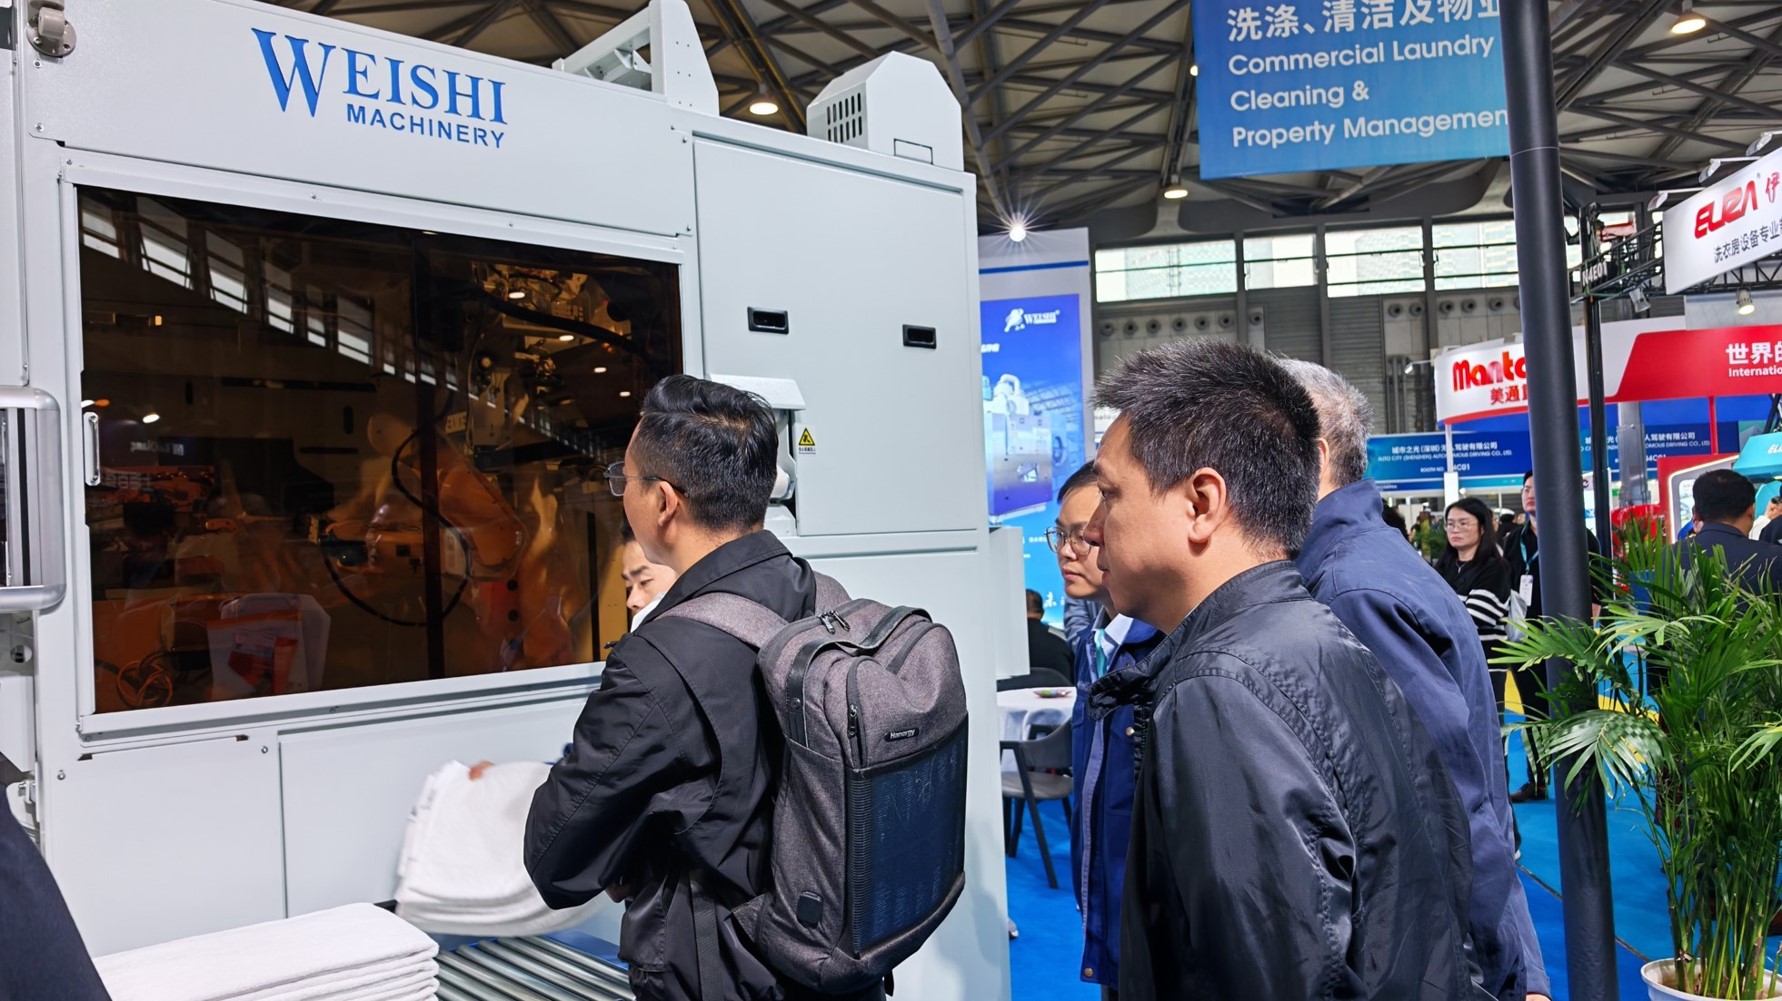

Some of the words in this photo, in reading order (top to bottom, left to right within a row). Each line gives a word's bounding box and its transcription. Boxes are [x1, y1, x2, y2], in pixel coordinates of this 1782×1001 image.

[1229, 43, 1384, 75] Commercial
[1393, 35, 1494, 62] Laundry
[251, 28, 508, 125] WEISHI
[1230, 85, 1344, 112] Cleaning
[1352, 80, 1370, 101] &
[347, 103, 505, 149] MACHINERY
[1232, 121, 1336, 149] Property
[1344, 109, 1509, 139] Managemen
[1713, 217, 1782, 263] 洗衣房设备专业
[1582, 260, 1607, 287] N4E01
